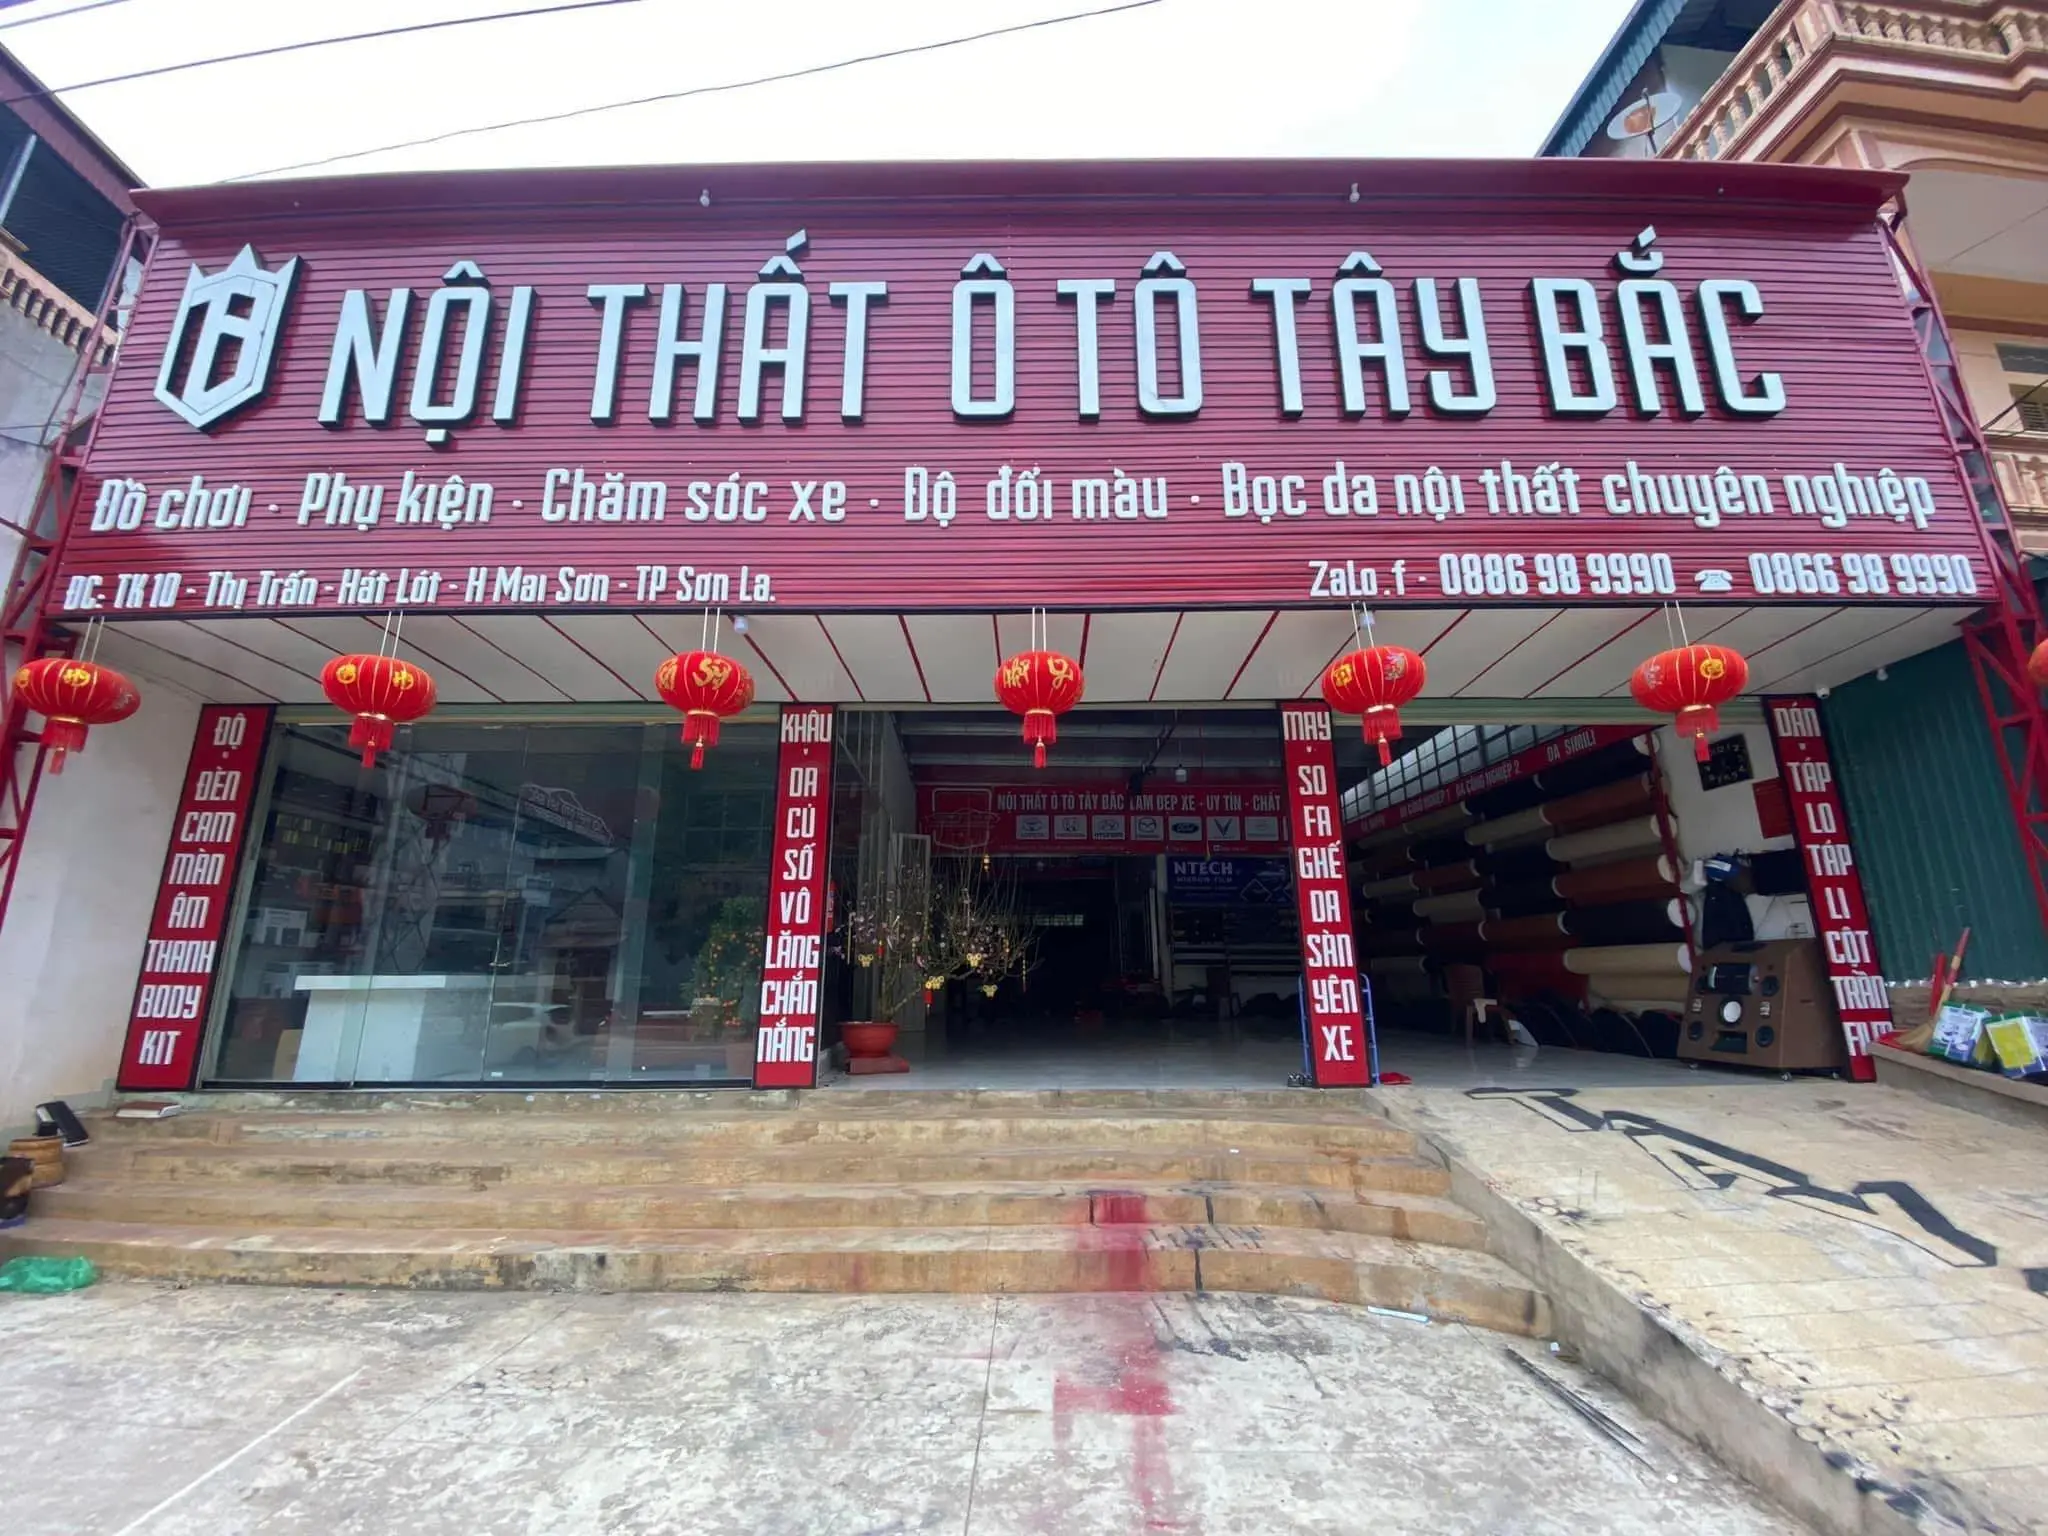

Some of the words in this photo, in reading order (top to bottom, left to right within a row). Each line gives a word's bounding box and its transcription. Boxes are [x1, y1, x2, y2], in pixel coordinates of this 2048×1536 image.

[318, 261, 535, 446] NỘI
[588, 229, 888, 425] THẤT
[952, 253, 1016, 420] Ô
[1057, 251, 1203, 421] TÔ
[1252, 251, 1498, 420] TÂY
[1530, 225, 1786, 421] BẮC
[91, 478, 148, 531] Đồ
[155, 476, 252, 528] chơi
[297, 472, 385, 531] Phụ
[396, 470, 494, 531] kiện
[542, 468, 668, 522] Chăm
[685, 472, 768, 523] sóc
[788, 481, 847, 523] xe
[904, 466, 957, 528] Độ
[986, 464, 1053, 521] đổi
[1071, 466, 1169, 520] màu
[1221, 461, 1307, 525] Bọc
[1322, 460, 1379, 517] da
[1394, 465, 1466, 522] nội
[1478, 460, 1581, 515] thất
[1601, 460, 1774, 529] chuyên
[1783, 462, 1937, 530] nghiệp
[205, 571, 249, 610] Thị
[257, 570, 318, 606] Trấn
[337, 568, 391, 605] Hát
[395, 568, 443, 604] Lót
[464, 567, 488, 604] H
[493, 566, 547, 604] Mai
[555, 567, 611, 603] Sơn
[635, 565, 668, 603] TP
[676, 566, 730, 603] Sơn
[739, 565, 777, 603] La.
[1439, 553, 1529, 596] 0886
[1534, 553, 1580, 595] 98
[1585, 553, 1677, 596] 9990
[1748, 553, 1840, 595] 0866
[1841, 553, 1890, 594] 98
[1890, 553, 1977, 595] 9990
[213, 712, 246, 750] ĐỘ
[781, 710, 832, 744] KHÂU
[1282, 711, 1332, 741] MAY
[1774, 702, 1821, 738] DÁN
[195, 766, 241, 802] ĐÈN
[790, 767, 818, 797] DA
[1298, 765, 1327, 796] SO
[1787, 757, 1832, 793] TÁP
[998, 791, 1017, 813] NỘI
[1020, 790, 1048, 811] THẤT
[1062, 790, 1076, 810] TÔ
[1078, 790, 1099, 811] TÂY
[1102, 790, 1125, 811] BẮC
[1181, 794, 1196, 811] XE
[1206, 794, 1220, 811] UY
[1805, 803, 1836, 834] LO
[180, 812, 236, 842] CAM
[1303, 805, 1331, 837] FA
[168, 848, 225, 885] MÀN
[783, 842, 816, 881] SỐ
[1299, 840, 1342, 879] GHẾ
[1806, 840, 1852, 876] TÁP
[168, 891, 210, 928] ÂM
[780, 887, 810, 924] VÔ
[1310, 890, 1341, 923] DA
[1824, 887, 1851, 920] LI
[145, 939, 217, 974] THANH
[765, 931, 820, 969] LĂNG
[1307, 929, 1354, 968] SÀN
[1824, 926, 1871, 968] CỘT
[136, 984, 202, 1019] BODY
[760, 971, 818, 1016] CHẮN
[1312, 974, 1358, 1015] YÊN
[138, 1029, 182, 1065] KIT
[757, 1018, 814, 1063] NẮNG
[1321, 1025, 1355, 1062] XE
